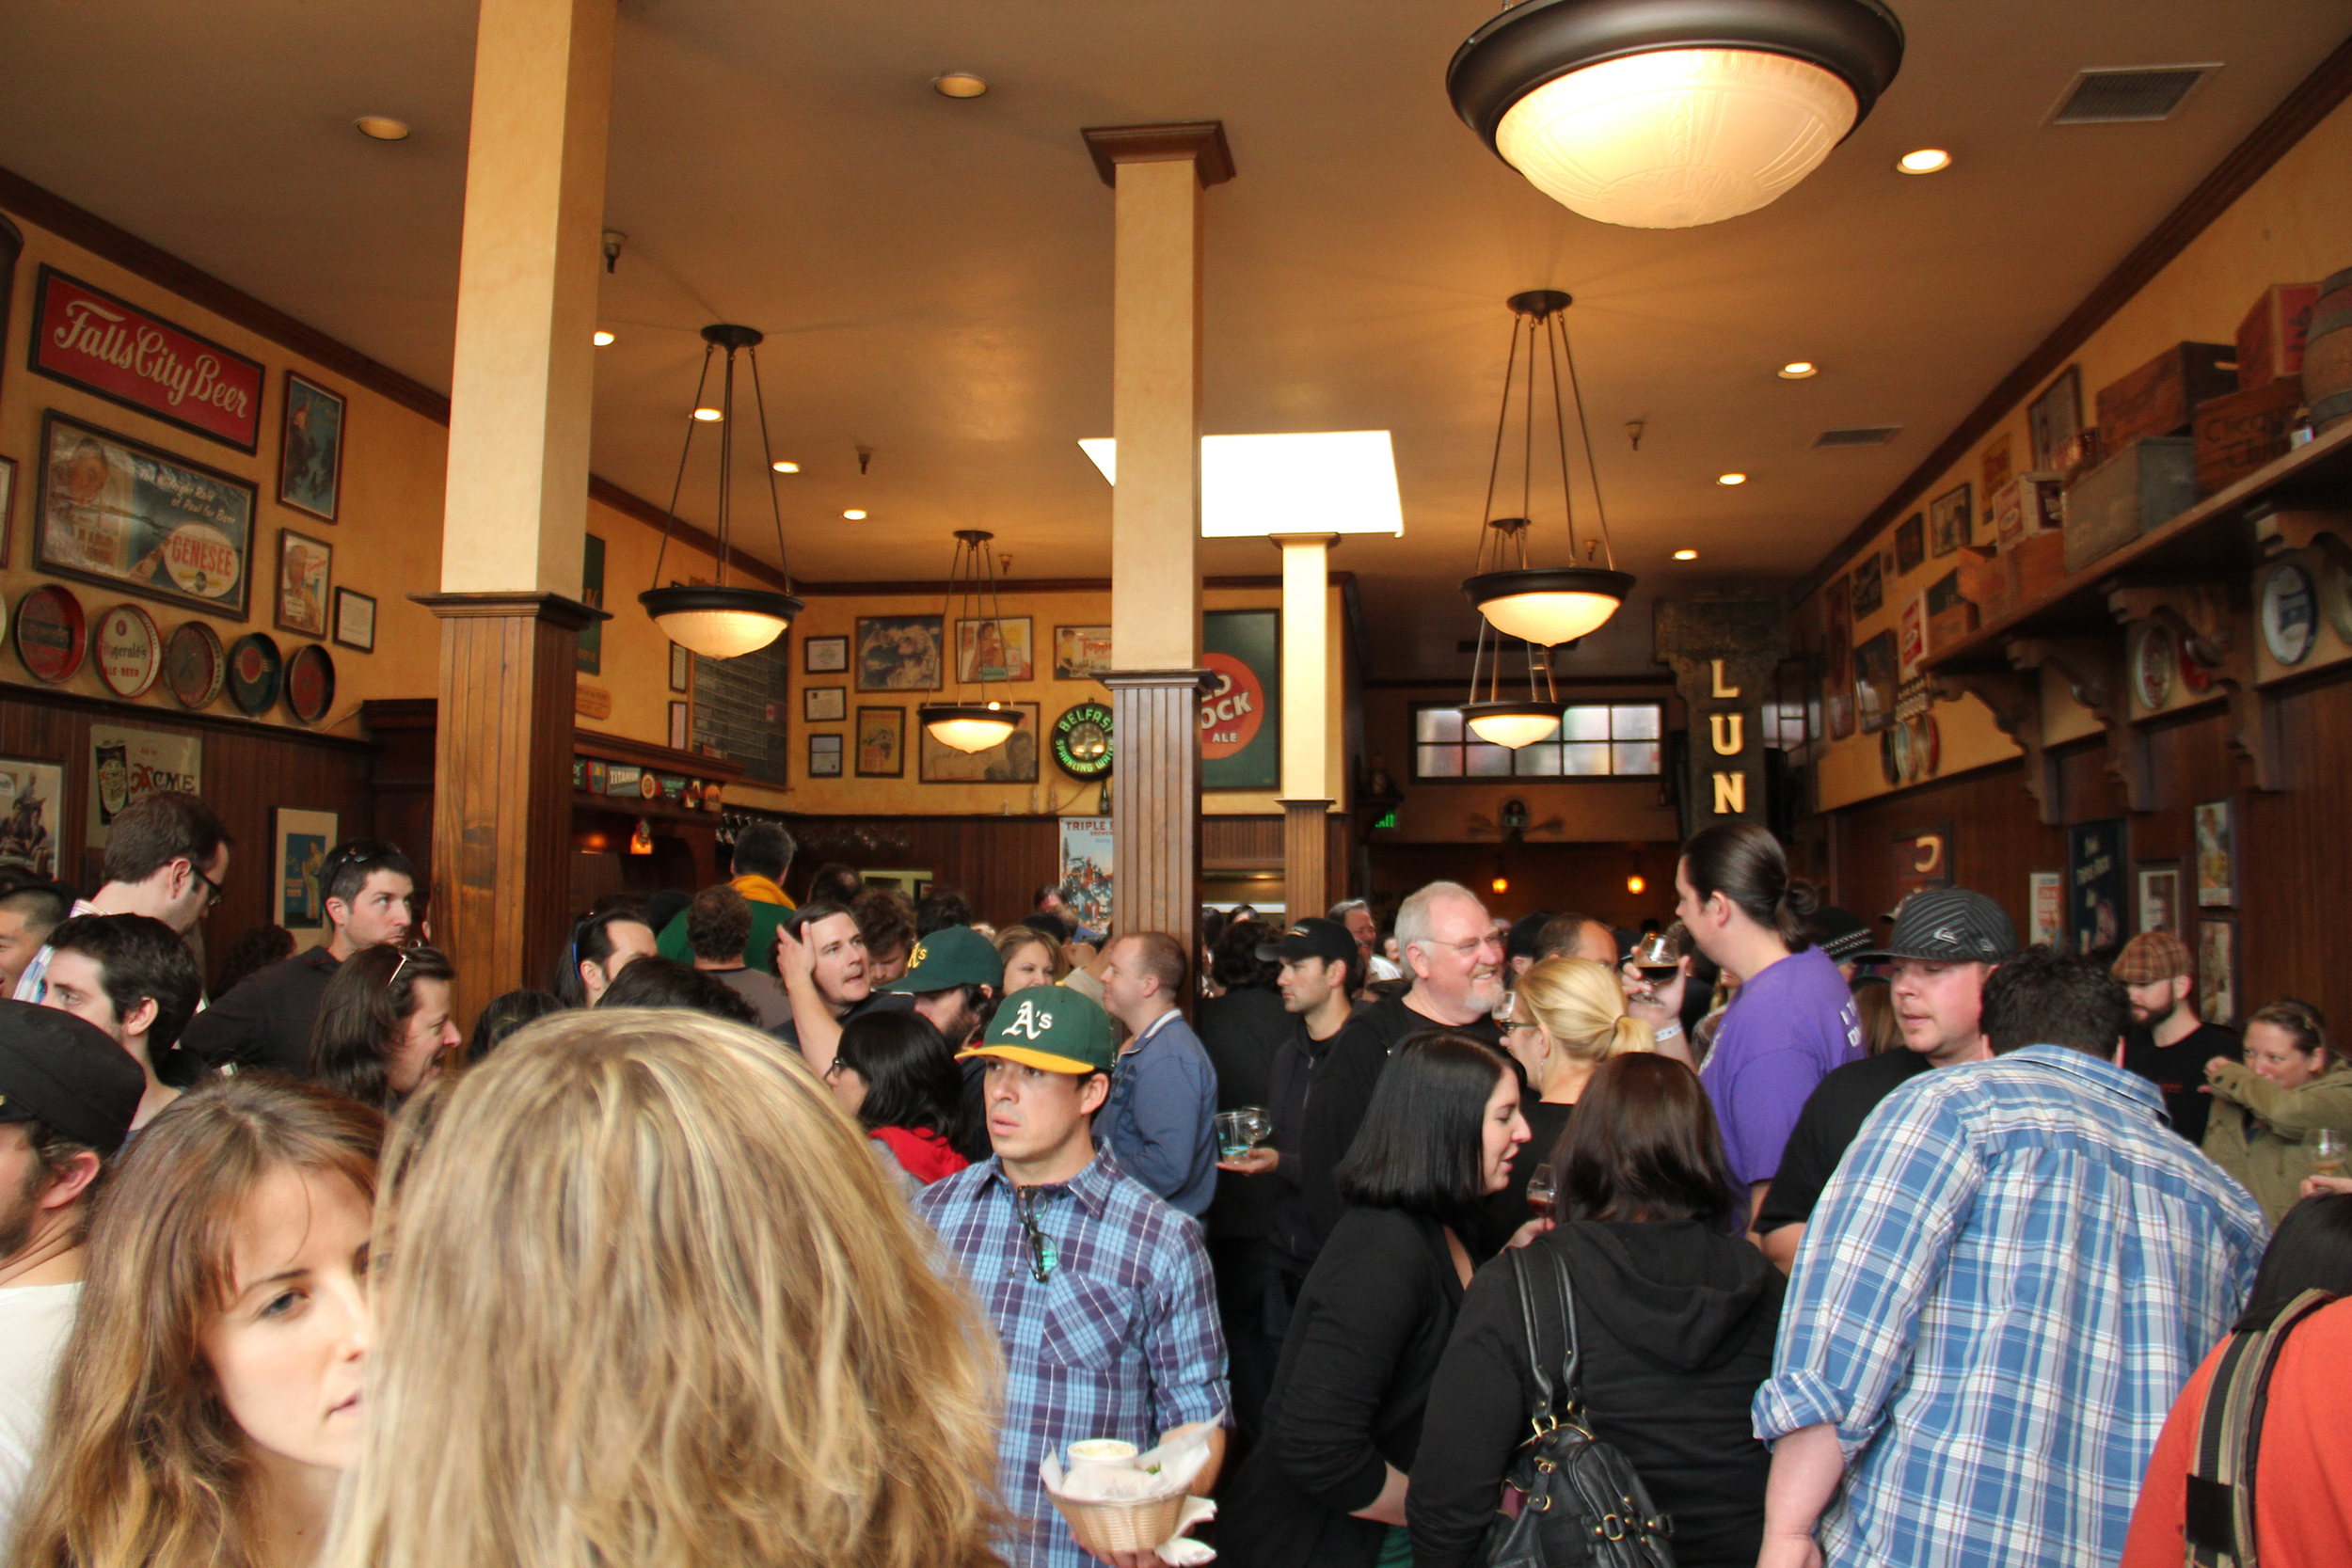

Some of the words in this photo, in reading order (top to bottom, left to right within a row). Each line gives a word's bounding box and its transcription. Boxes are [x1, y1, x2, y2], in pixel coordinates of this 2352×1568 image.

[54, 301, 135, 369] Falls
[135, 326, 193, 405] City
[189, 355, 247, 418] Beer
[171, 534, 233, 576] GENESEE
[120, 667, 139, 677] BEER
[1058, 708, 1113, 732] BELFAST
[1201, 691, 1252, 729] OCK
[1212, 732, 1237, 742] ALE
[1056, 739, 1093, 772] SPARKLING
[131, 763, 195, 793] ACME
[1066, 821, 1105, 831] TRIPLE
[1001, 1000, 1054, 1040] A's
